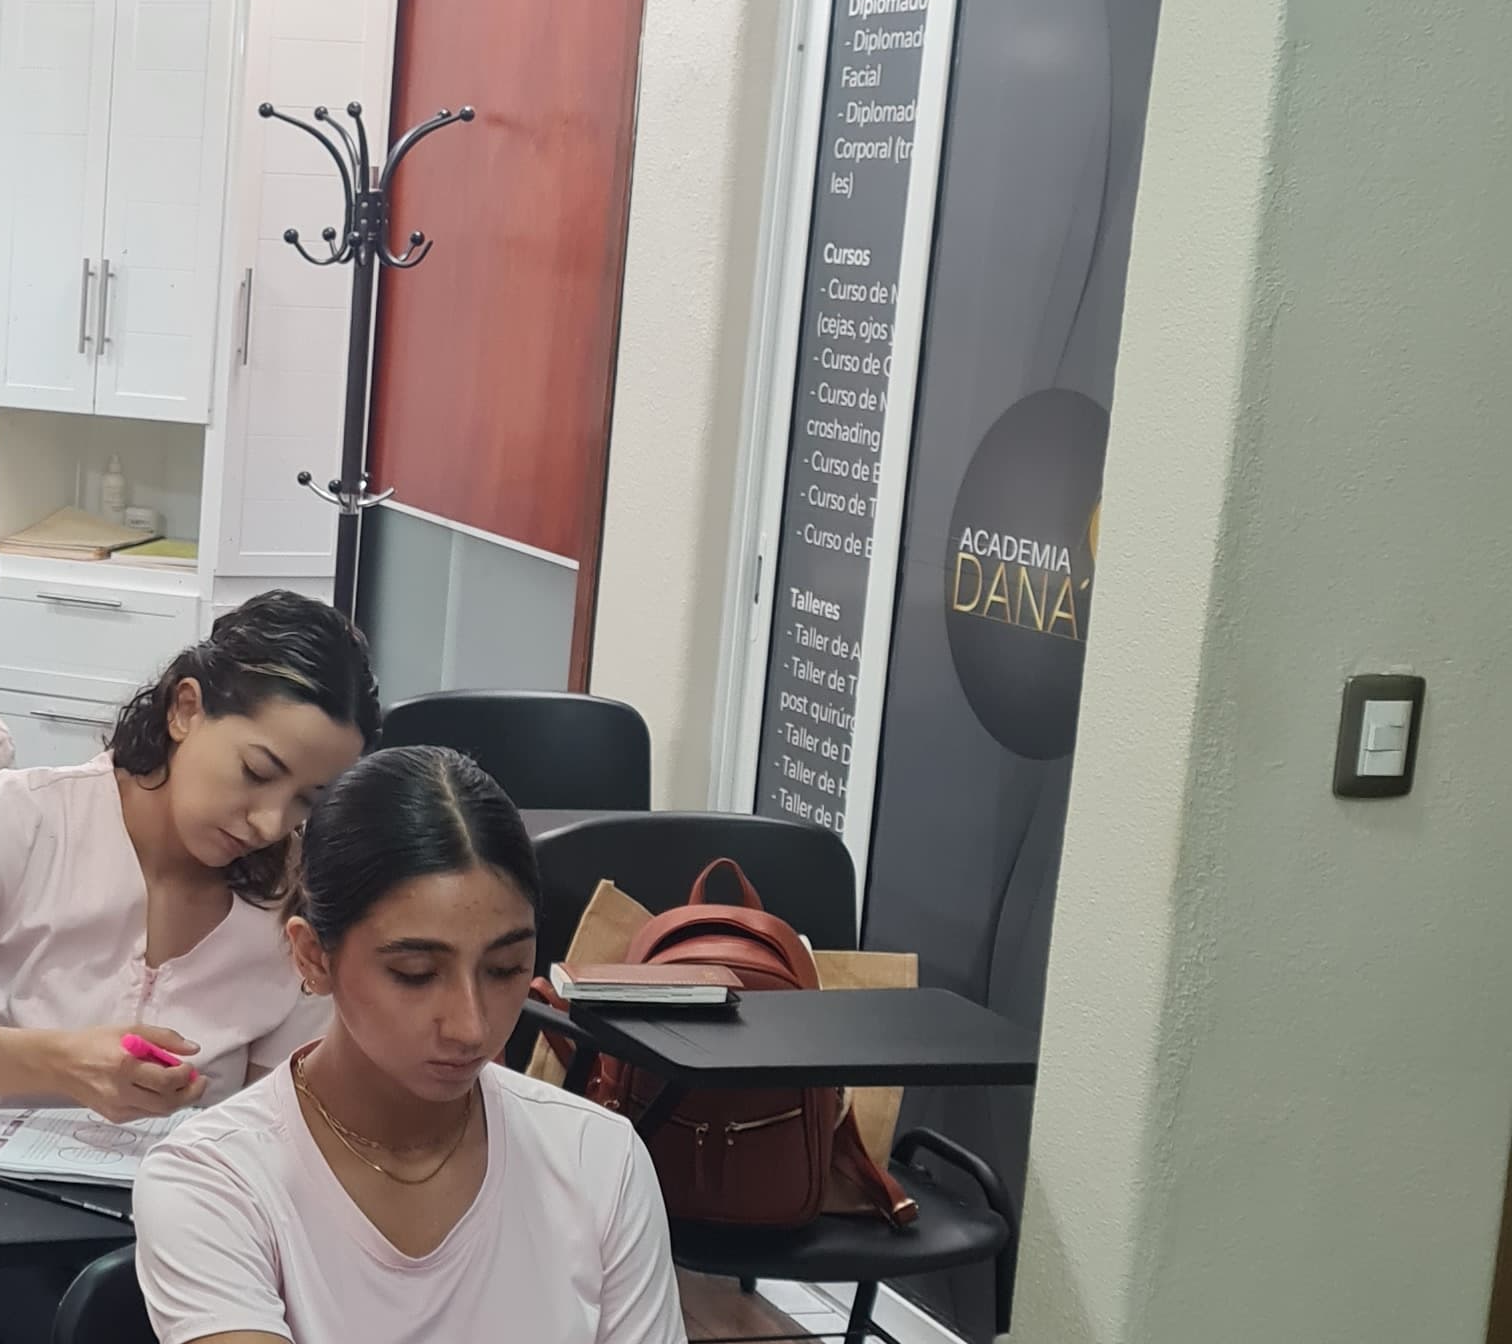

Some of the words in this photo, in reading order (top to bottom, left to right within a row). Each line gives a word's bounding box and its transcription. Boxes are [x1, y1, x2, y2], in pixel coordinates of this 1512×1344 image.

[853, 24, 925, 55] Diplomad
[841, 64, 882, 88] Facial
[846, 99, 918, 128] Diplomad
[834, 136, 893, 163] Corporal
[895, 136, 915, 164] (tr
[830, 171, 854, 199] les)
[824, 243, 871, 266] Cursos
[828, 278, 867, 302] Curso
[870, 281, 888, 304] de
[817, 312, 857, 340] (cejas,
[859, 316, 888, 343] ojos
[821, 348, 860, 372] Curso
[862, 353, 881, 375] de
[818, 382, 856, 407] Curso
[859, 387, 877, 411] de
[807, 418, 881, 452] croshading
[811, 451, 849, 477] Curso
[851, 457, 870, 481] de
[808, 485, 846, 511] Curso
[848, 492, 866, 517] de
[804, 523, 841, 550] Curso
[844, 532, 862, 556] de
[959, 527, 1072, 575] ACADEMIA
[790, 587, 841, 621] Talleres
[795, 623, 829, 652] Taller
[831, 635, 849, 658] de
[791, 656, 826, 686] Taller
[828, 669, 845, 693] de
[780, 691, 808, 715] post
[785, 722, 819, 753] Taller
[821, 737, 839, 760] de
[781, 755, 816, 785] Taller
[818, 770, 835, 794] de
[778, 788, 812, 819] Taller
[815, 804, 832, 828] de
